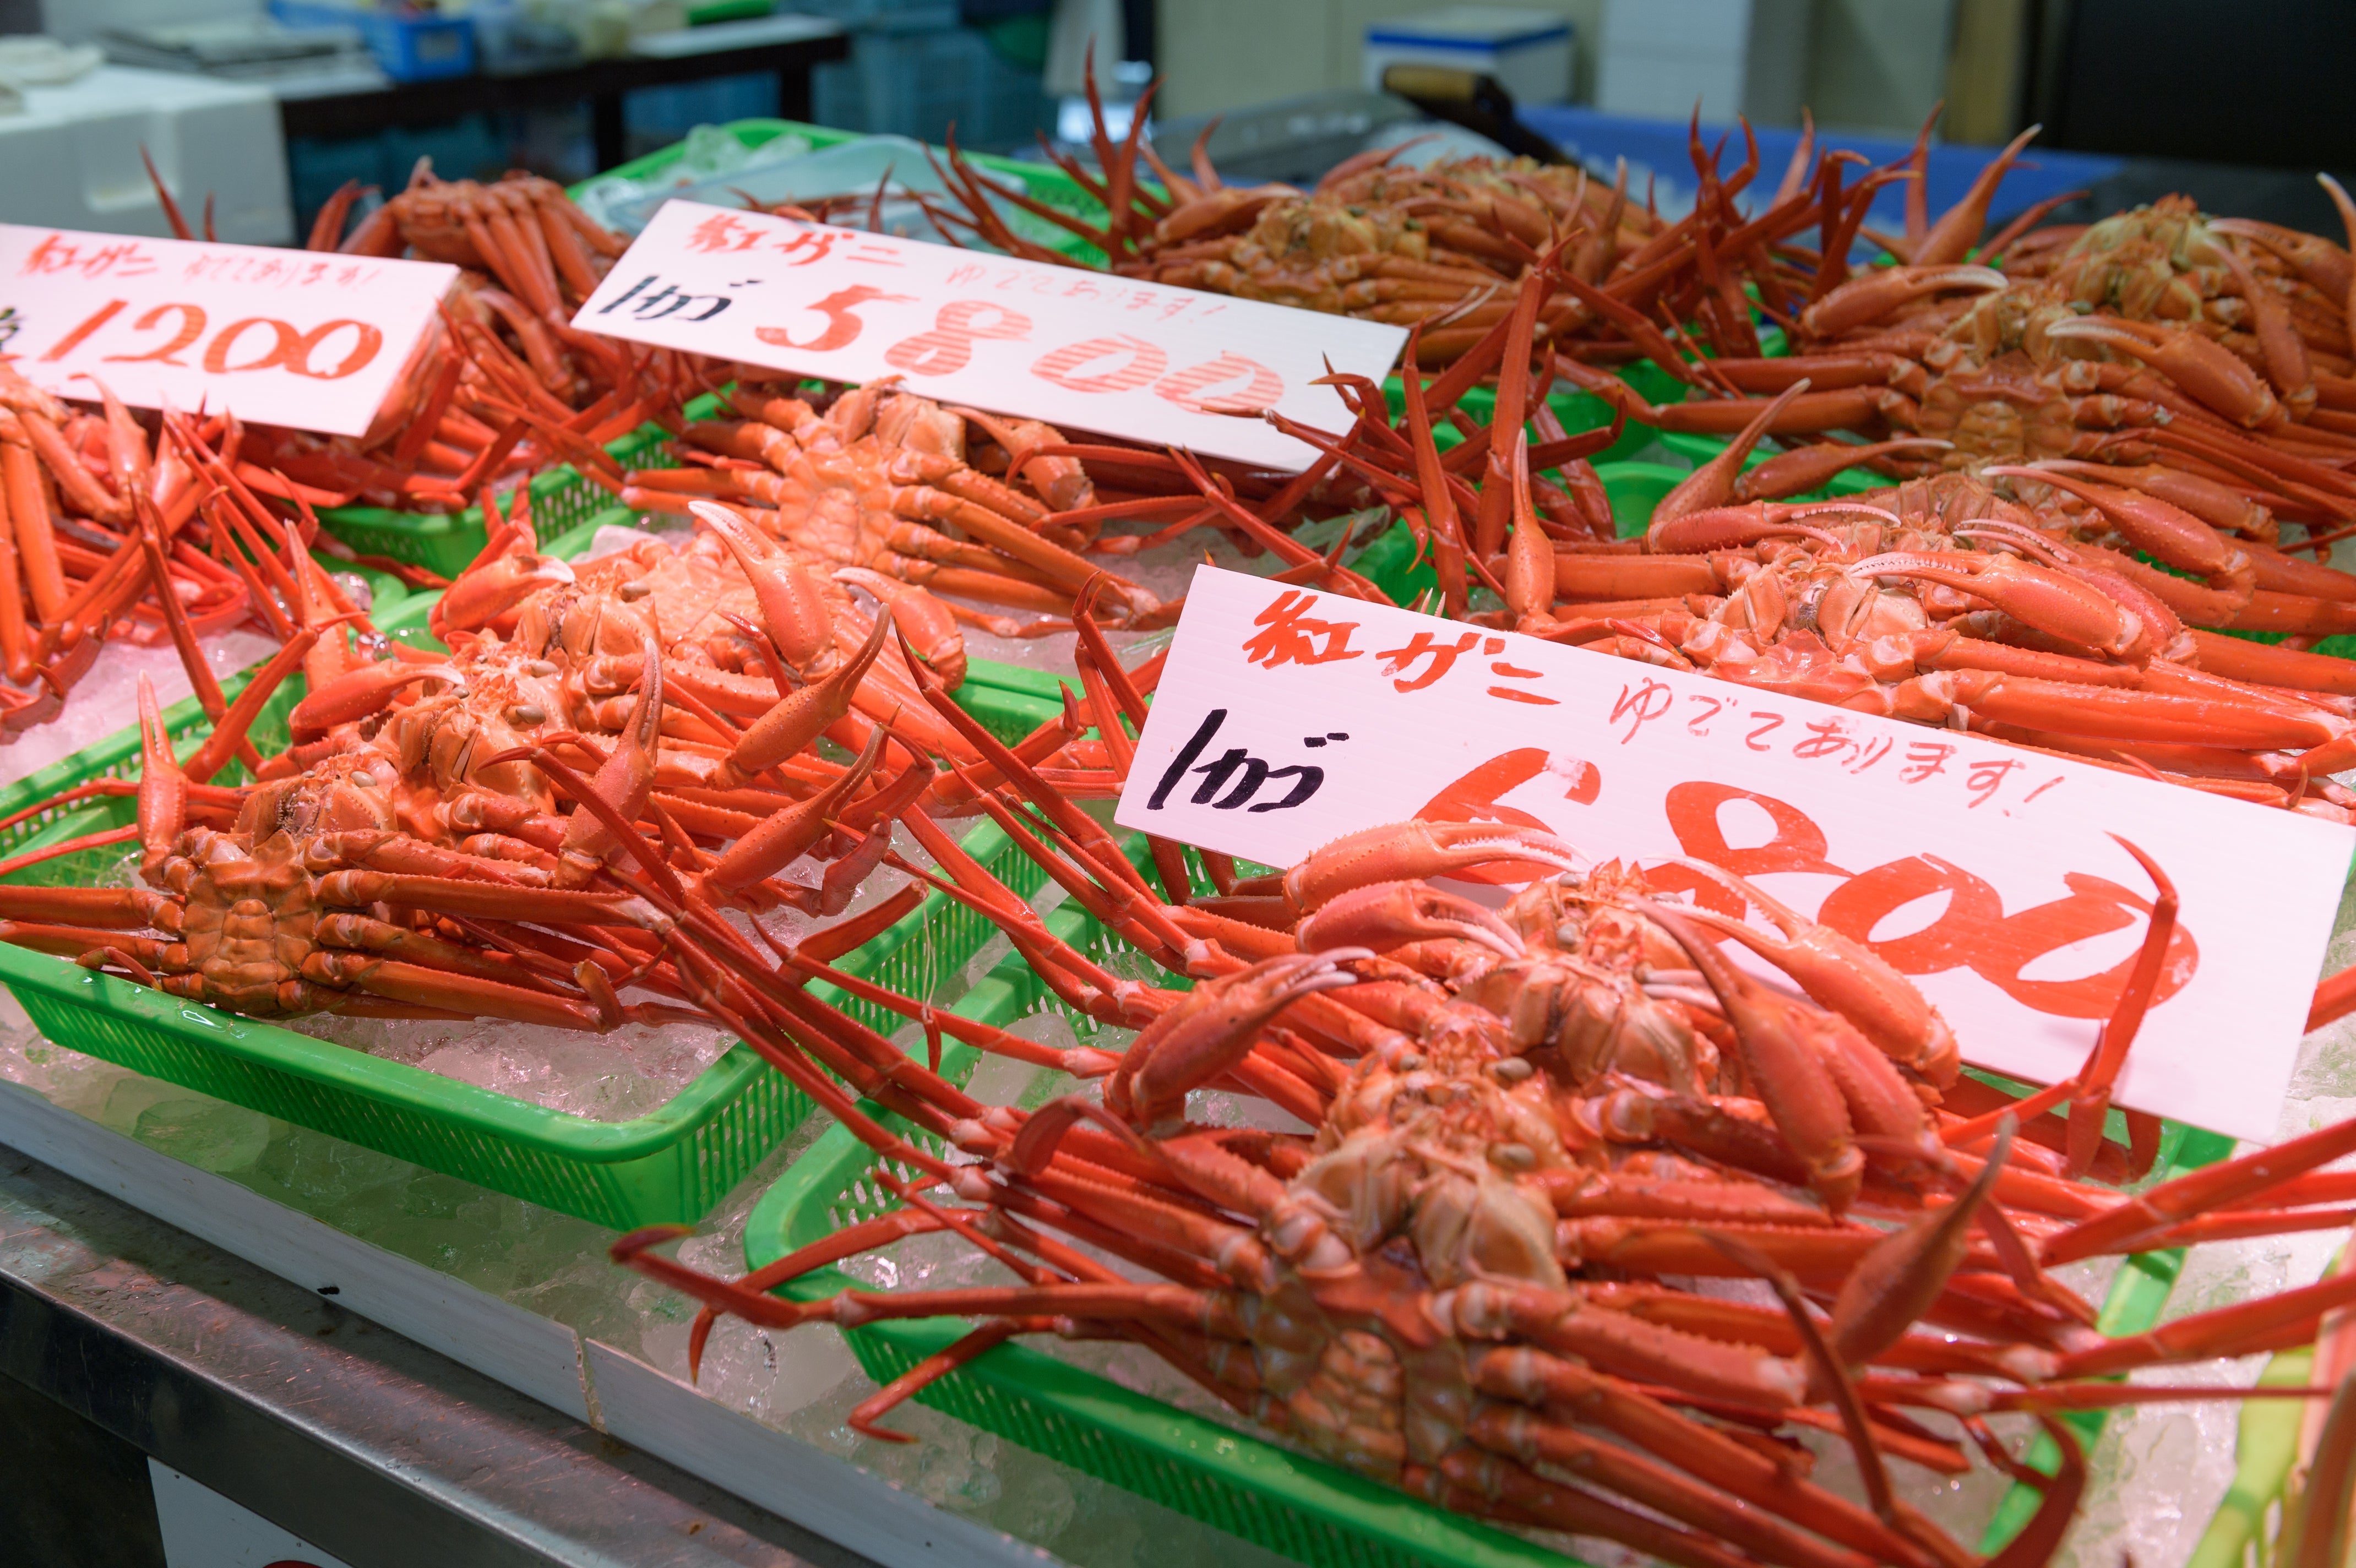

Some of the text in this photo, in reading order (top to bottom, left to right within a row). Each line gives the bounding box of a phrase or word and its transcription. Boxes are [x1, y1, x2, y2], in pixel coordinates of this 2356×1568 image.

[37, 298, 383, 380] 1200
[755, 283, 1285, 416] 5800
[1242, 590, 1561, 706] 紅ガニ
